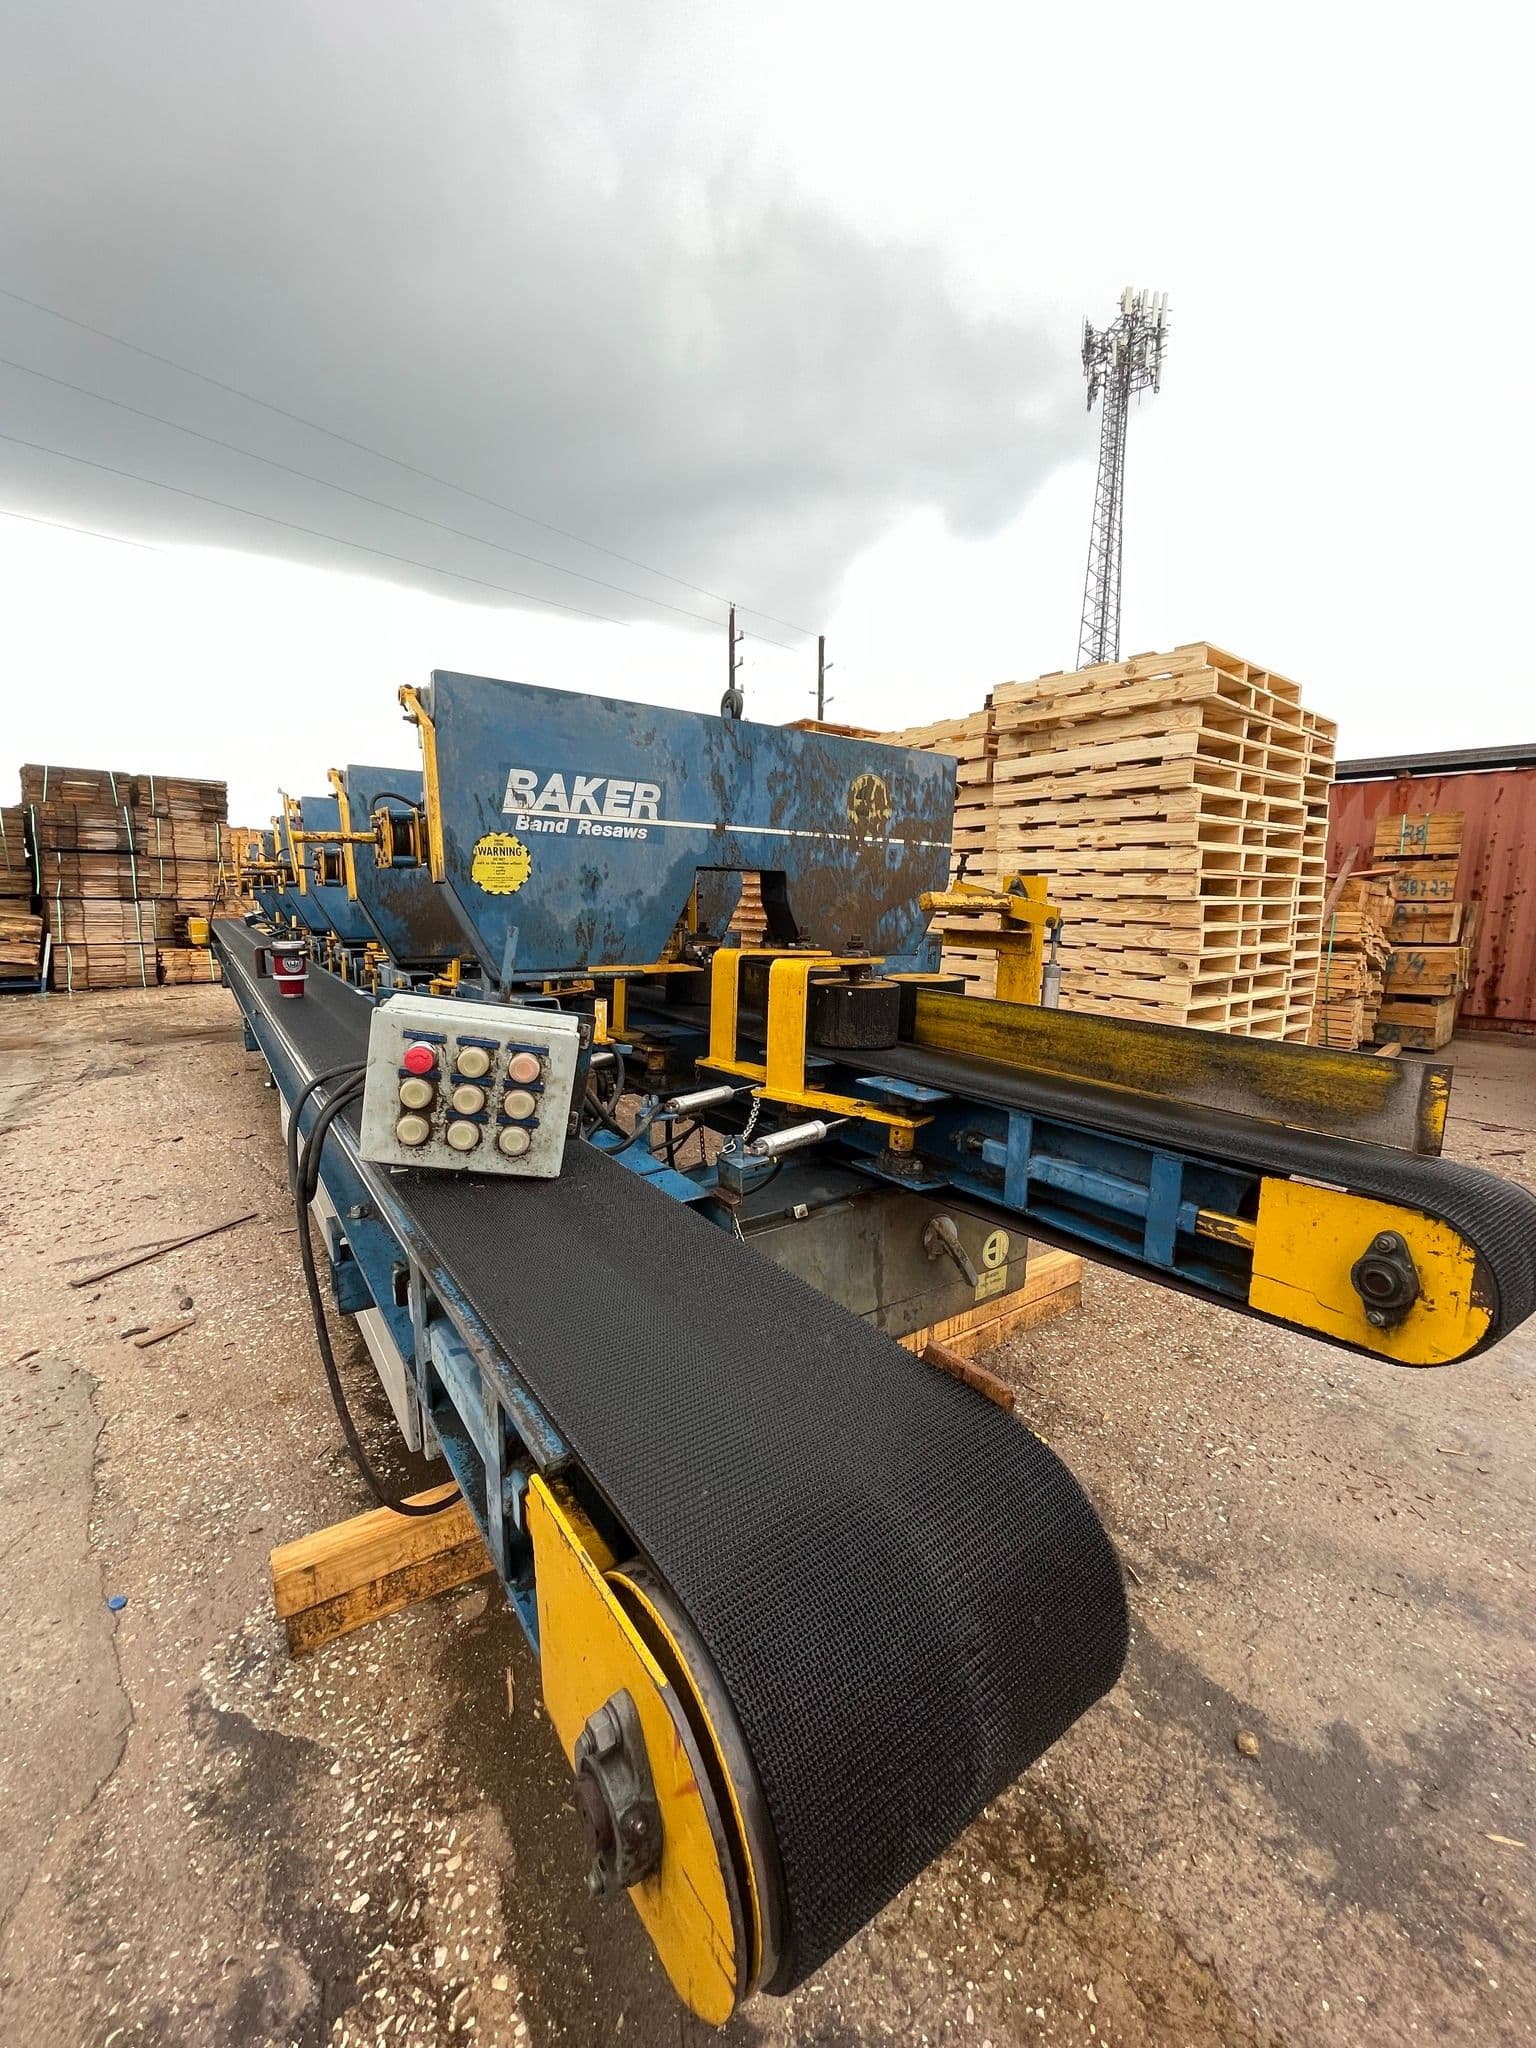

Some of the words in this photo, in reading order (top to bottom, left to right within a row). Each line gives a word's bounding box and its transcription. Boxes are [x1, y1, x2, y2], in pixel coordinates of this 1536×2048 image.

[503, 769, 661, 820] BAKER
[515, 815, 569, 833] Band
[577, 820, 648, 840] Resaws
[478, 847, 522, 856] WARNING
